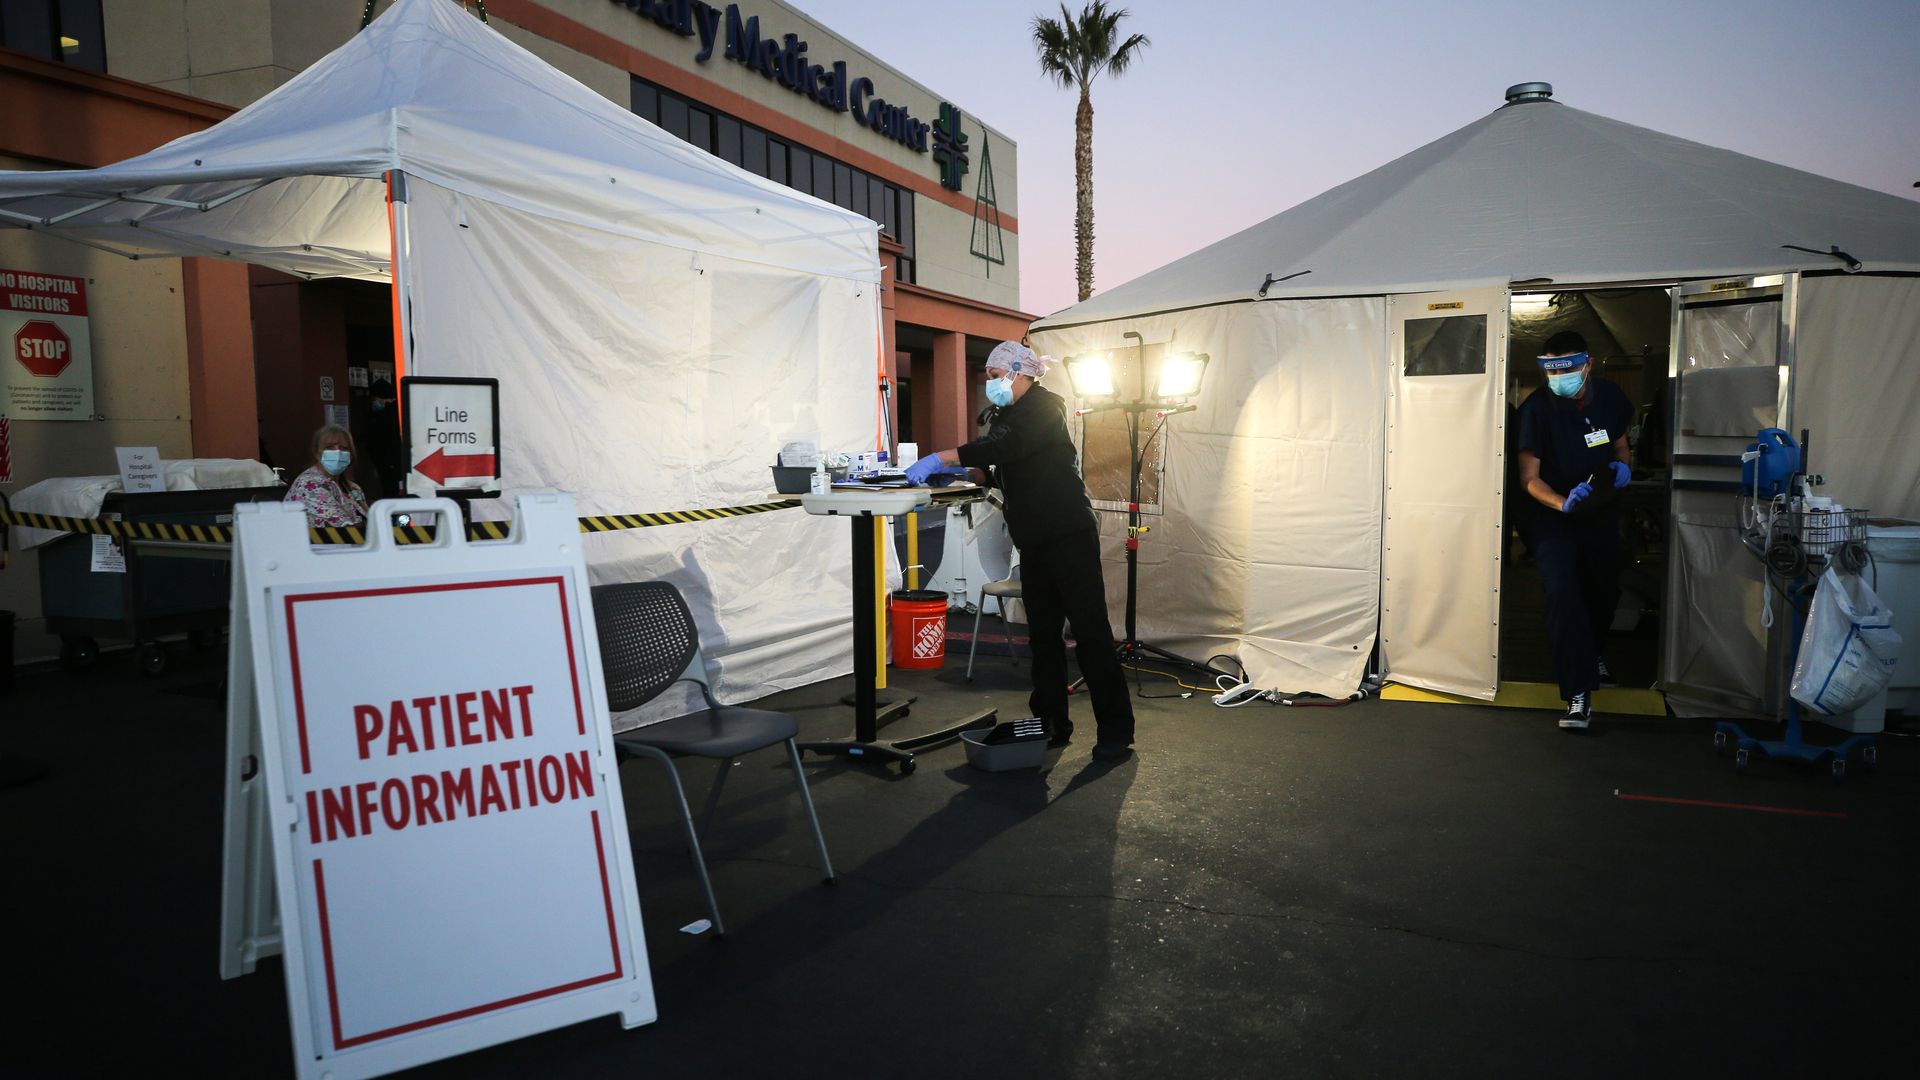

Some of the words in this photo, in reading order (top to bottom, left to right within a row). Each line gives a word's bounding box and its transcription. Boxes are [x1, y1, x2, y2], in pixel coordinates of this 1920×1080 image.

[725, 4, 848, 112] Medical
[850, 77, 931, 153] Center
[18, 275, 78, 294] HOSPITAL
[9, 294, 70, 312] VISITORS
[20, 338, 66, 359] STOP
[435, 406, 468, 423] Line
[427, 427, 477, 444] Forms
[917, 621, 934, 639] THE
[353, 684, 534, 760] PATIENT
[306, 750, 595, 844] INFORMATION
